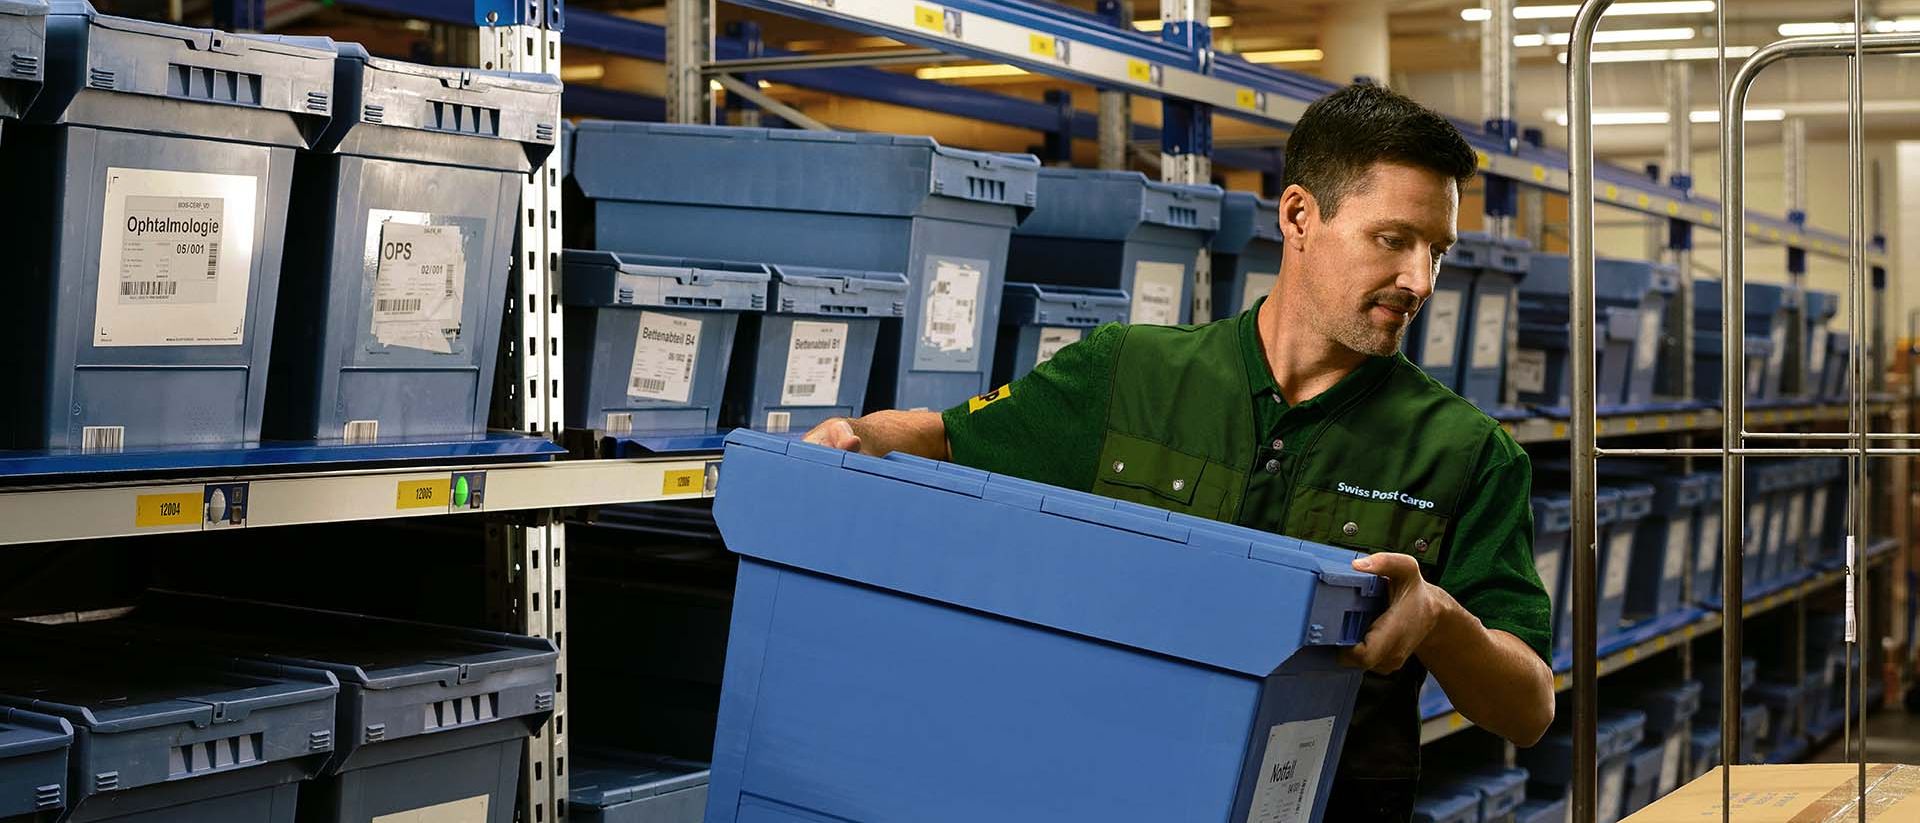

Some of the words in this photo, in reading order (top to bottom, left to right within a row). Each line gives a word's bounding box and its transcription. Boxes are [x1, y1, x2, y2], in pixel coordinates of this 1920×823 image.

[127, 216, 219, 237] Ophtalmologie
[176, 243, 205, 254] 05/001
[384, 242, 412, 260] OPS
[642, 326, 685, 344] Bettenabteil
[685, 333, 696, 346] B4
[416, 487, 433, 500] 12005
[1337, 482, 1370, 498] Swiss
[1371, 490, 1400, 501] Post
[1399, 493, 1434, 510] Cargo
[160, 502, 181, 516] 12004
[1269, 759, 1298, 784] Notfall
